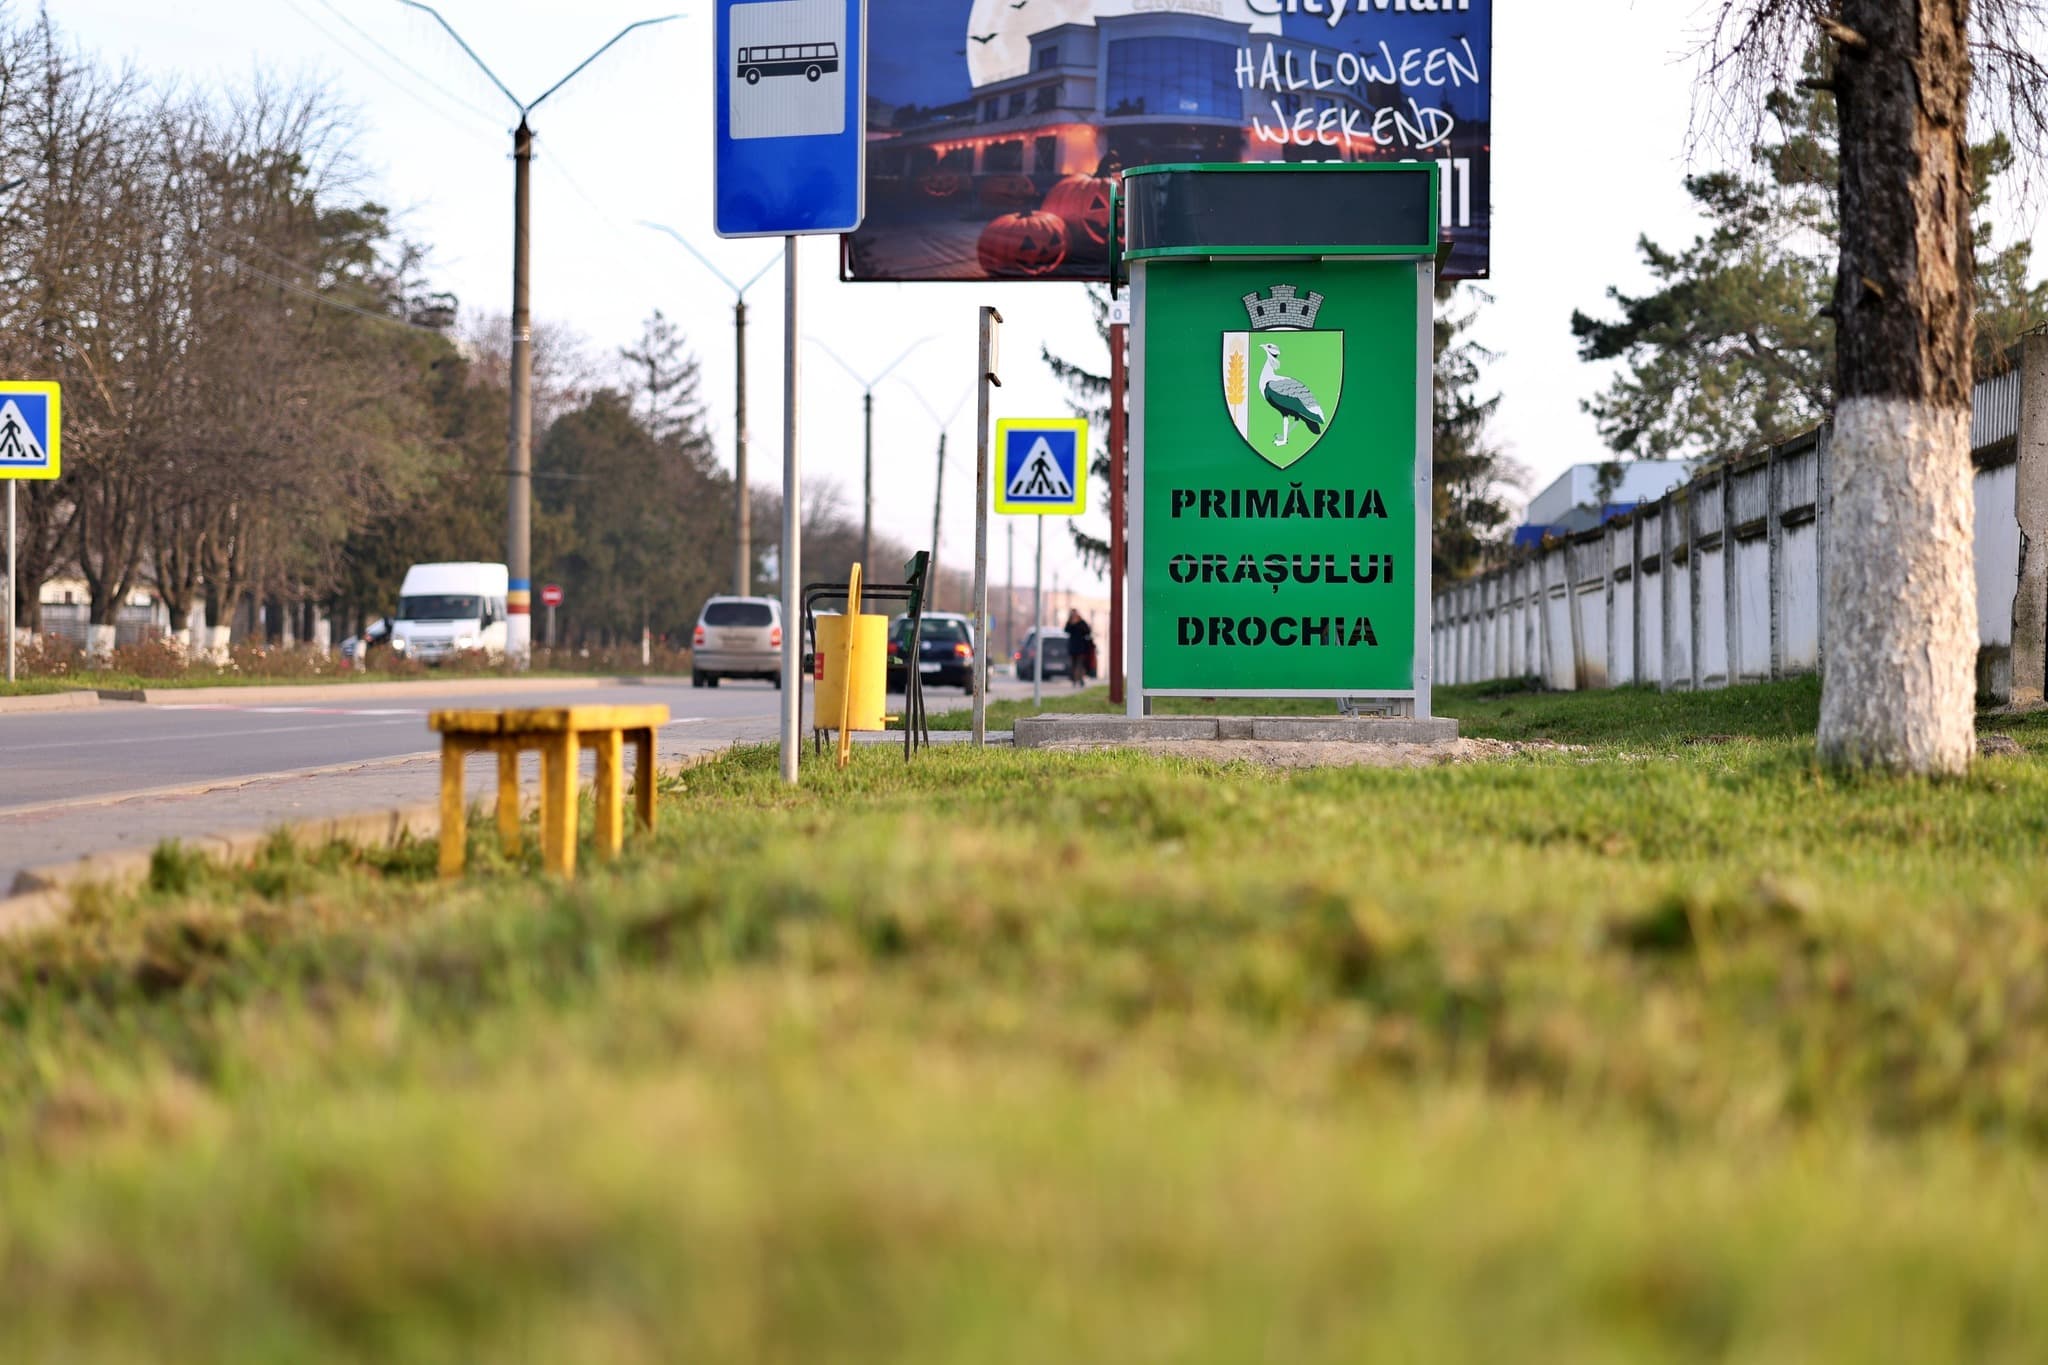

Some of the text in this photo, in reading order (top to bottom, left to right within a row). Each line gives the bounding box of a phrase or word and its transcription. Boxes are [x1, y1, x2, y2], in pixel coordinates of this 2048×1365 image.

[1235, 38, 1480, 92] HALLOWEEN
[1252, 97, 1455, 149] WEEKEND
[1171, 481, 1388, 519] PRIMĂRIA
[1168, 553, 1393, 594] ORAȘULUI
[1177, 616, 1378, 646] DROCHIA
